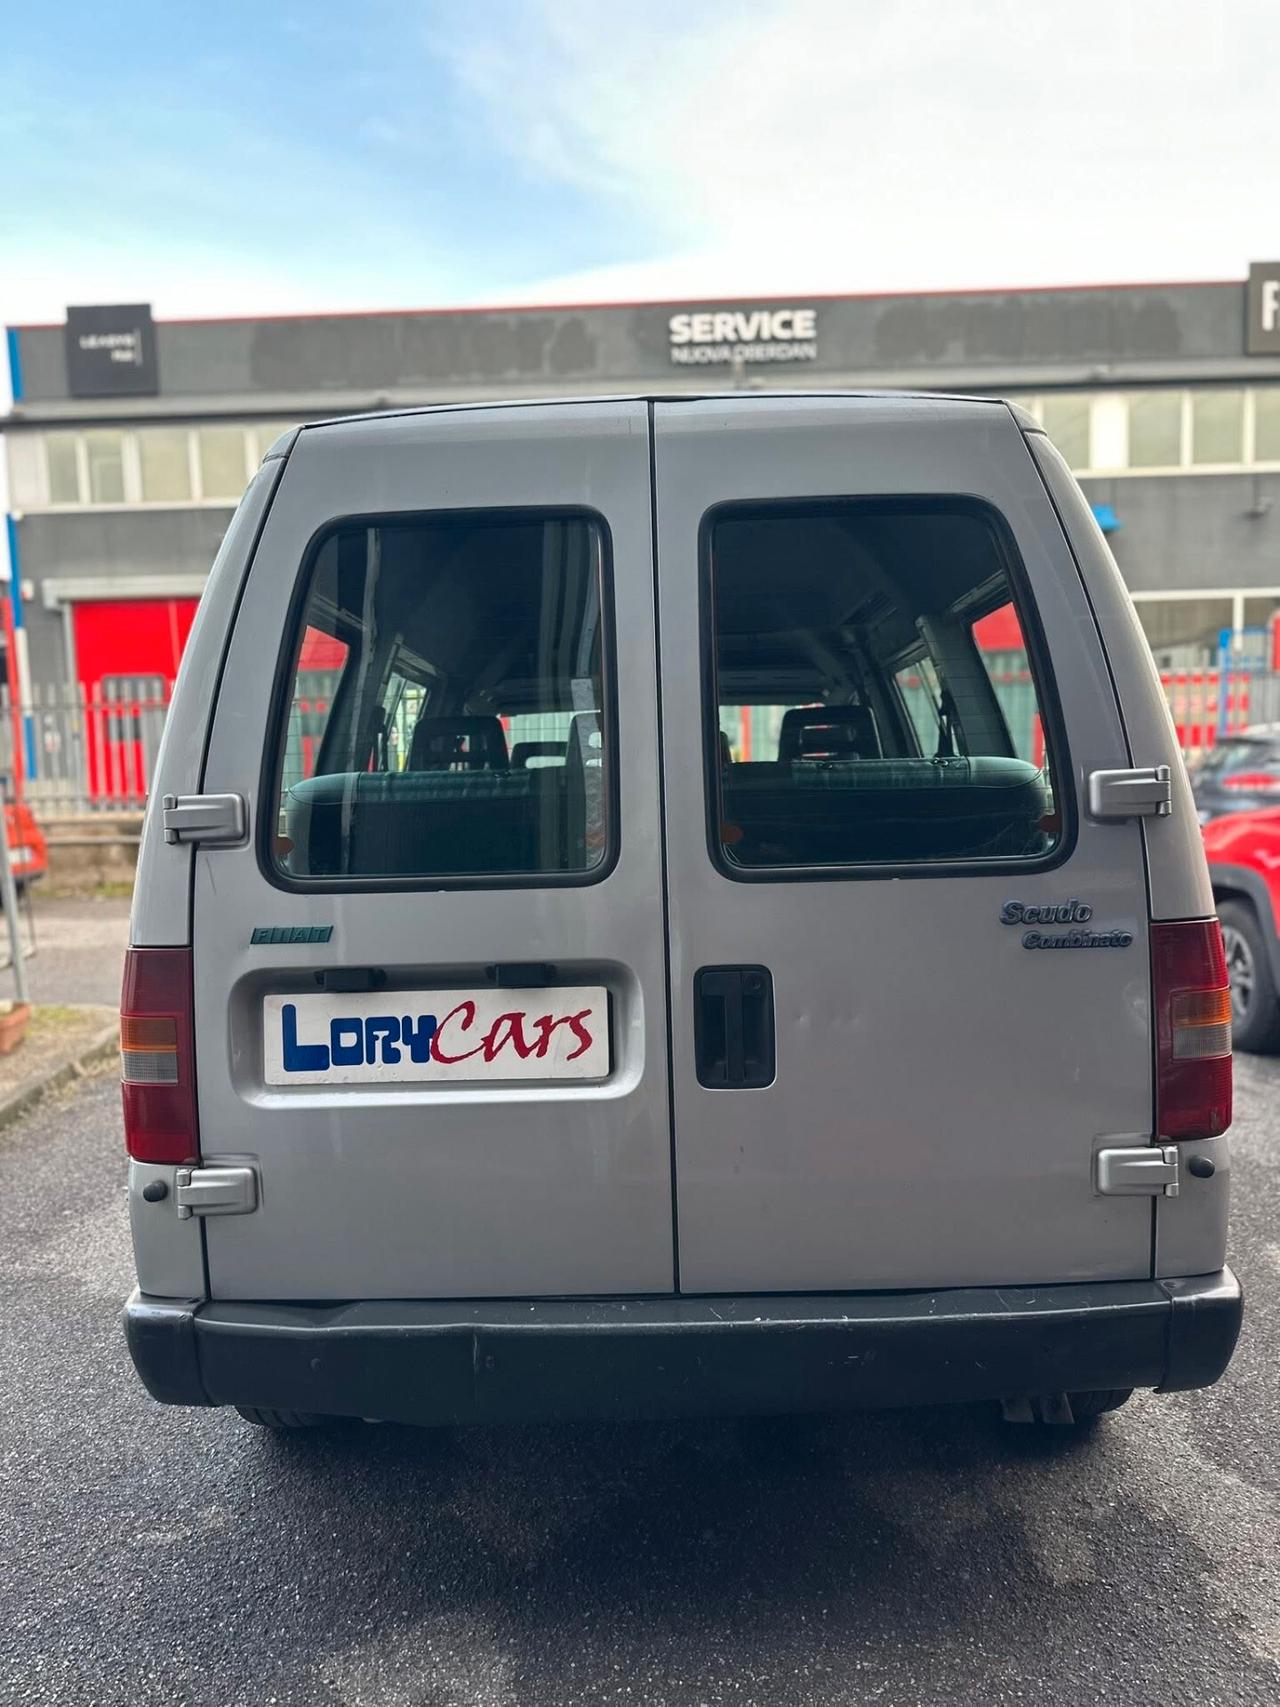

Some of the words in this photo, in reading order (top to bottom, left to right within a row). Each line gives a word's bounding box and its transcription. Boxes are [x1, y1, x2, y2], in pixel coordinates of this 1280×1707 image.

[1262, 281, 1280, 331] F
[669, 309, 817, 344] SERVICE
[1000, 898, 1093, 925] Scudo
[256, 927, 329, 943] FIAT
[1022, 928, 1134, 950] Combinato
